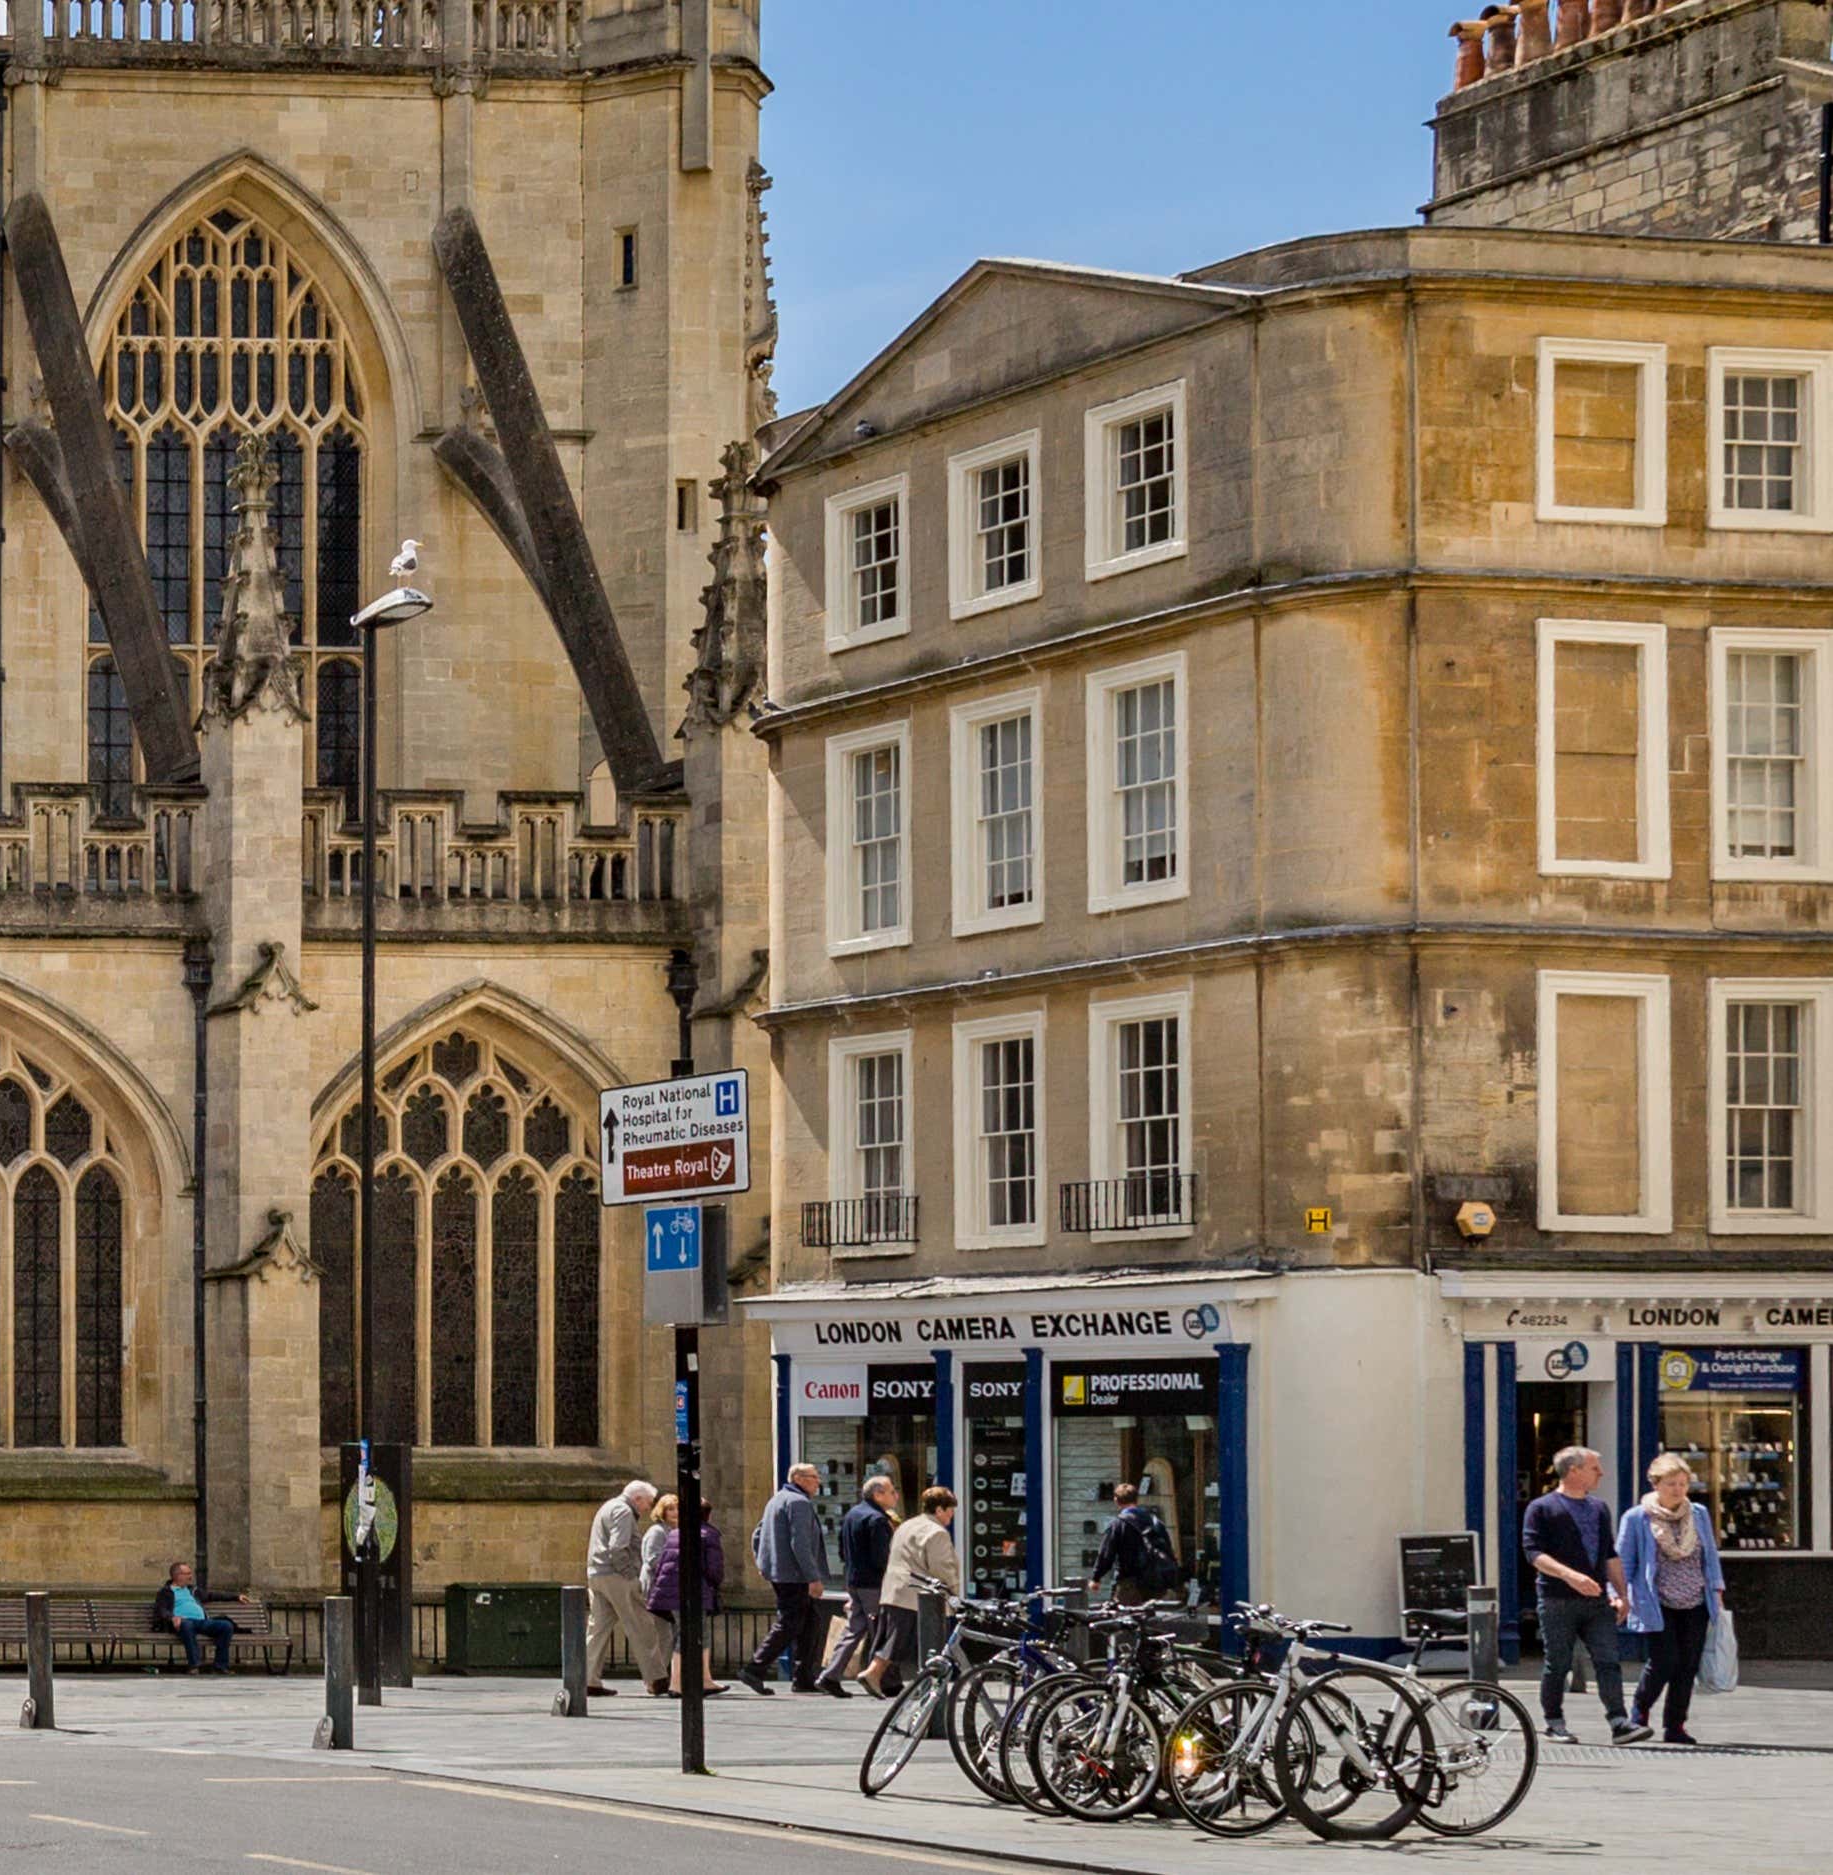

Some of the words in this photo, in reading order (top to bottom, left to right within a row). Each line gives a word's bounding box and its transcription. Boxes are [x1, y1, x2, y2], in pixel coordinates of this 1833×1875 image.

[622, 1092, 655, 1110] Royal
[659, 1083, 711, 1104] National
[719, 1084, 735, 1113] H
[622, 1108, 672, 1128] Hospital
[675, 1106, 693, 1120] for
[623, 1127, 686, 1146] Rheumatic
[690, 1120, 744, 1138] Diseases
[626, 1163, 671, 1180] Theatre
[674, 1156, 709, 1177] Royal
[1519, 1314, 1568, 1326] 462234
[1628, 1308, 1720, 1326] LONDON
[1766, 1308, 1833, 1326] CAME
[815, 1321, 902, 1344] LONDON
[916, 1316, 1016, 1342] CAMERA
[1031, 1311, 1172, 1338] EXCHANGE
[1714, 1350, 1782, 1362] Part-Exchange
[1711, 1363, 1751, 1375] Outright
[1753, 1363, 1796, 1373] Purchase
[804, 1381, 860, 1399] Canon
[872, 1381, 934, 1398] SONY
[969, 1382, 1023, 1397] SONY
[1090, 1373, 1204, 1391] PROFESSIONAL
[1090, 1393, 1119, 1405] Dealer
